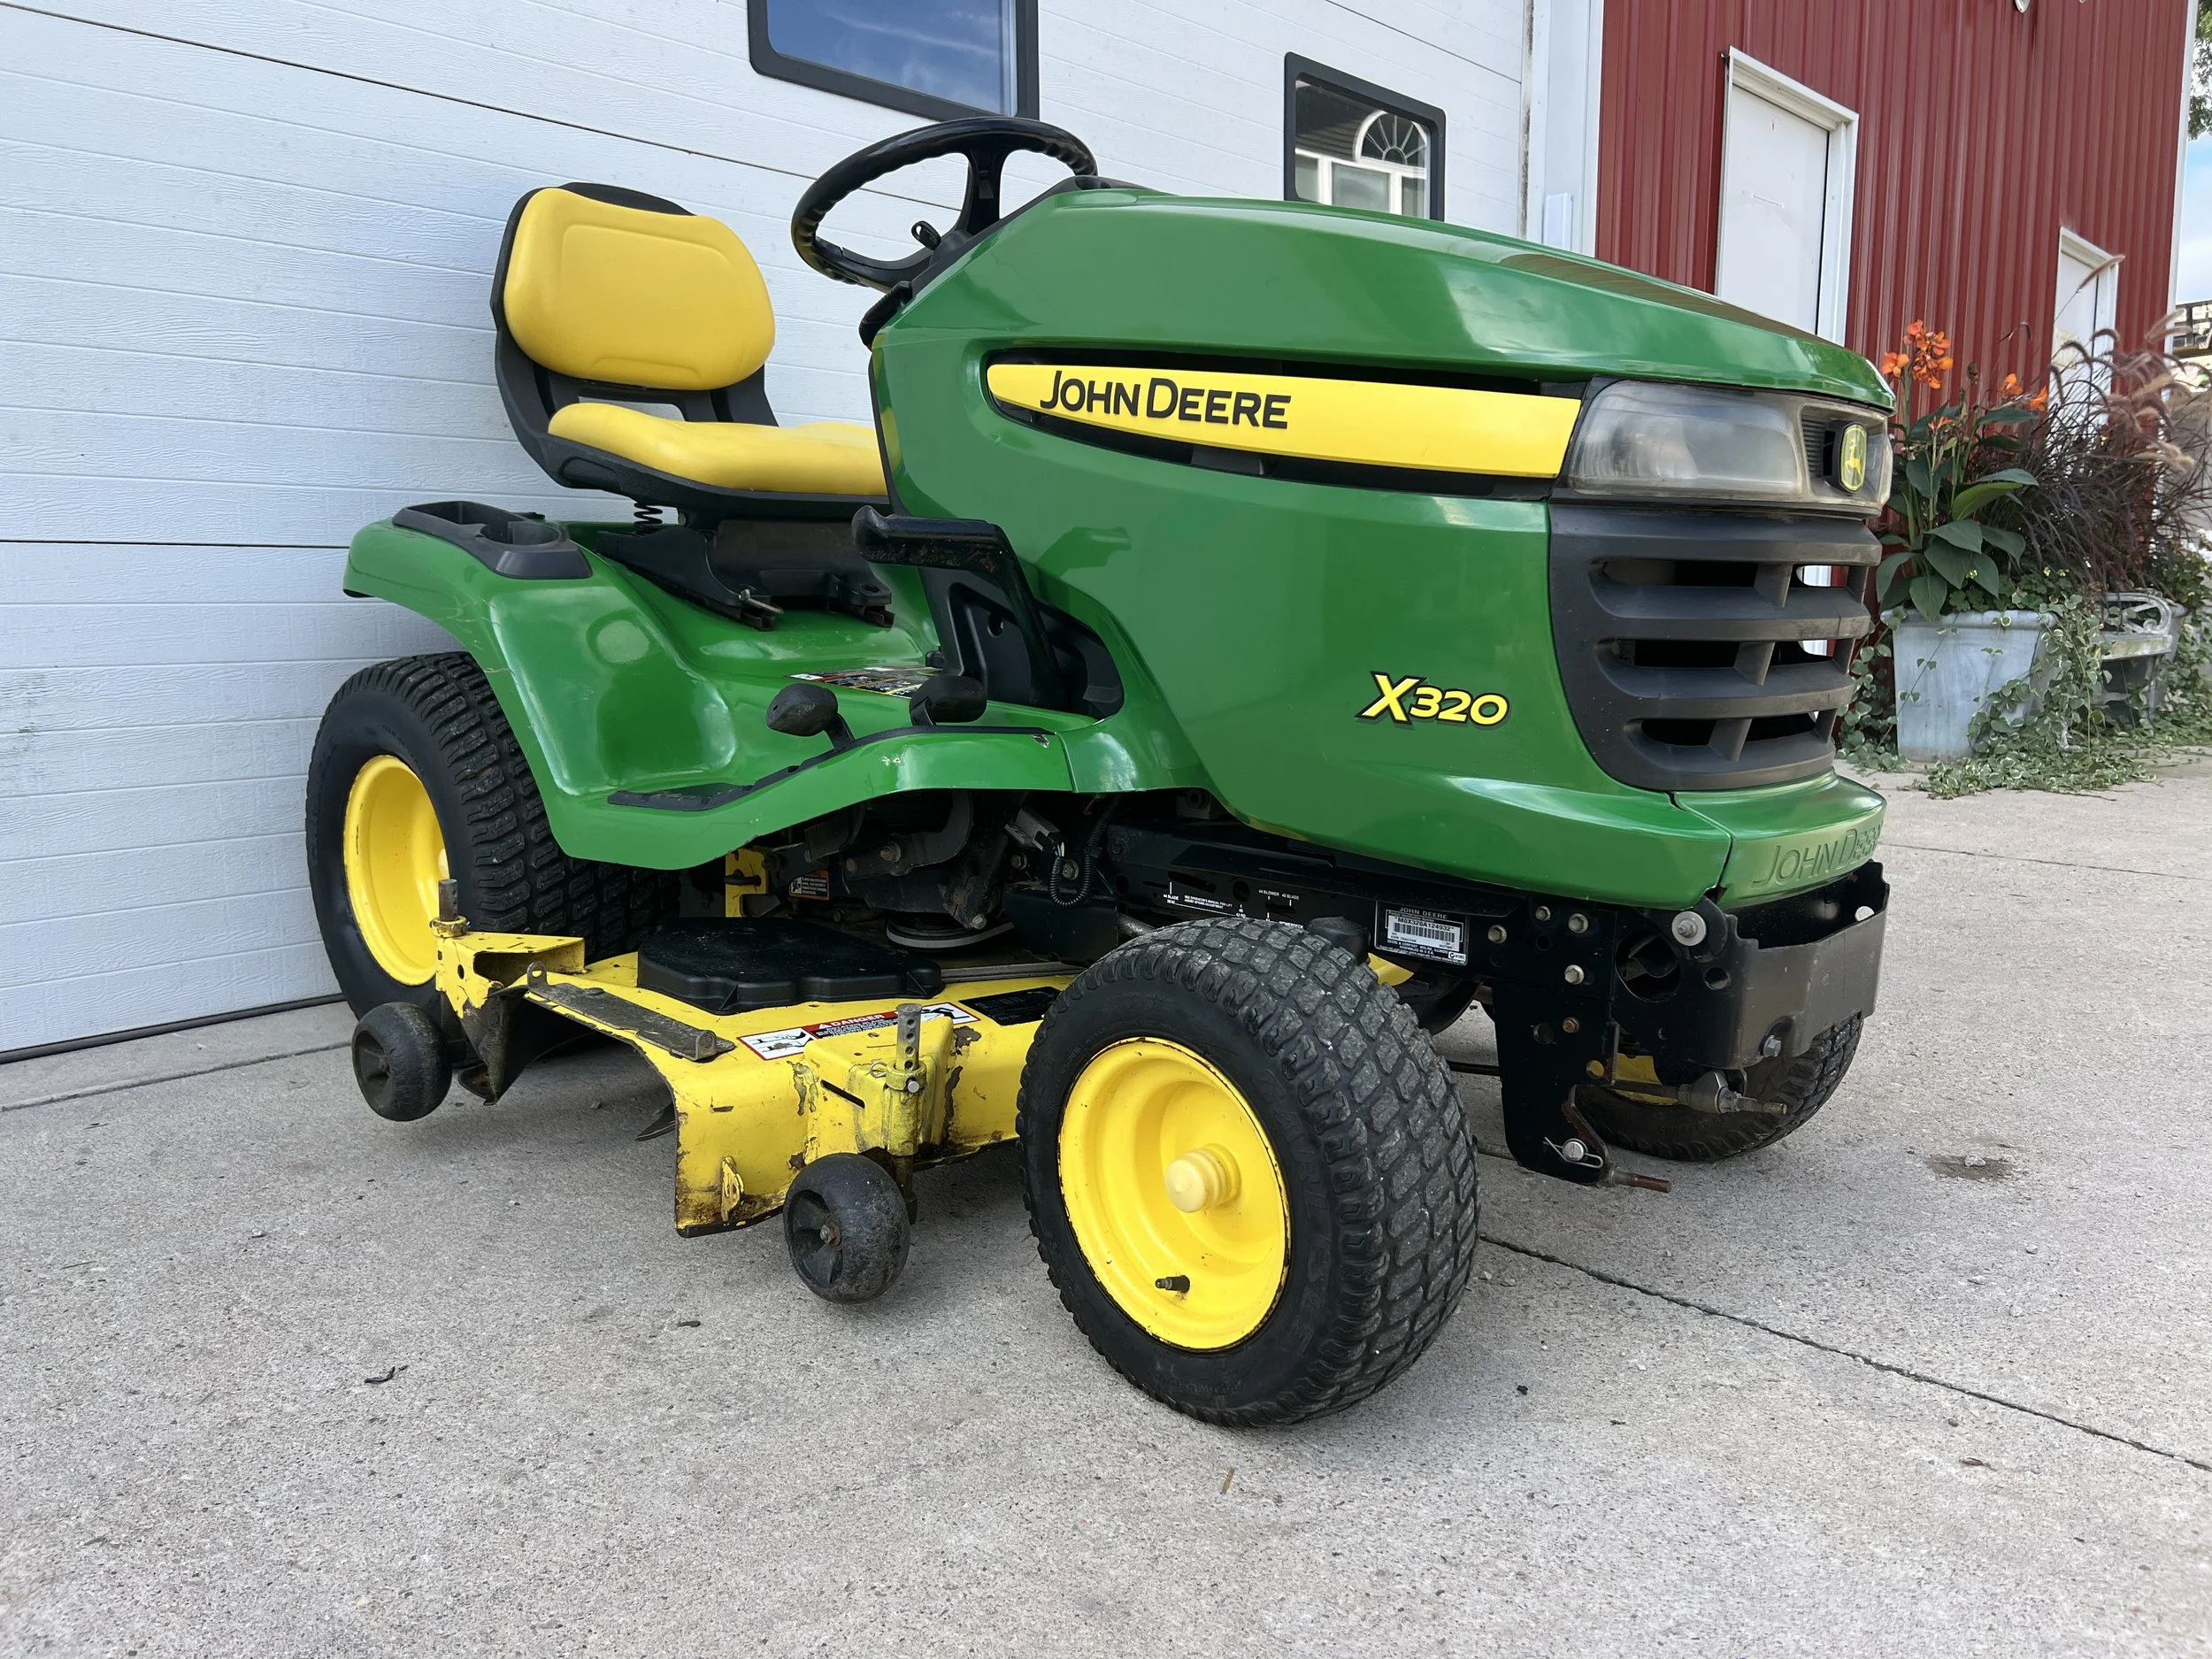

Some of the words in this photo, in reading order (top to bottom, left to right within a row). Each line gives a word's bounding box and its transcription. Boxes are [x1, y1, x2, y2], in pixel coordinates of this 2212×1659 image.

[1040, 370, 1141, 417] JOHN
[1146, 377, 1292, 430] DEERE
[1354, 670, 1510, 727] X320
[1749, 841, 1838, 890] JOHN
[1398, 906, 1420, 915] JOHN
[1422, 910, 1448, 919] DEERE
[831, 1014, 886, 1026] DANGER
